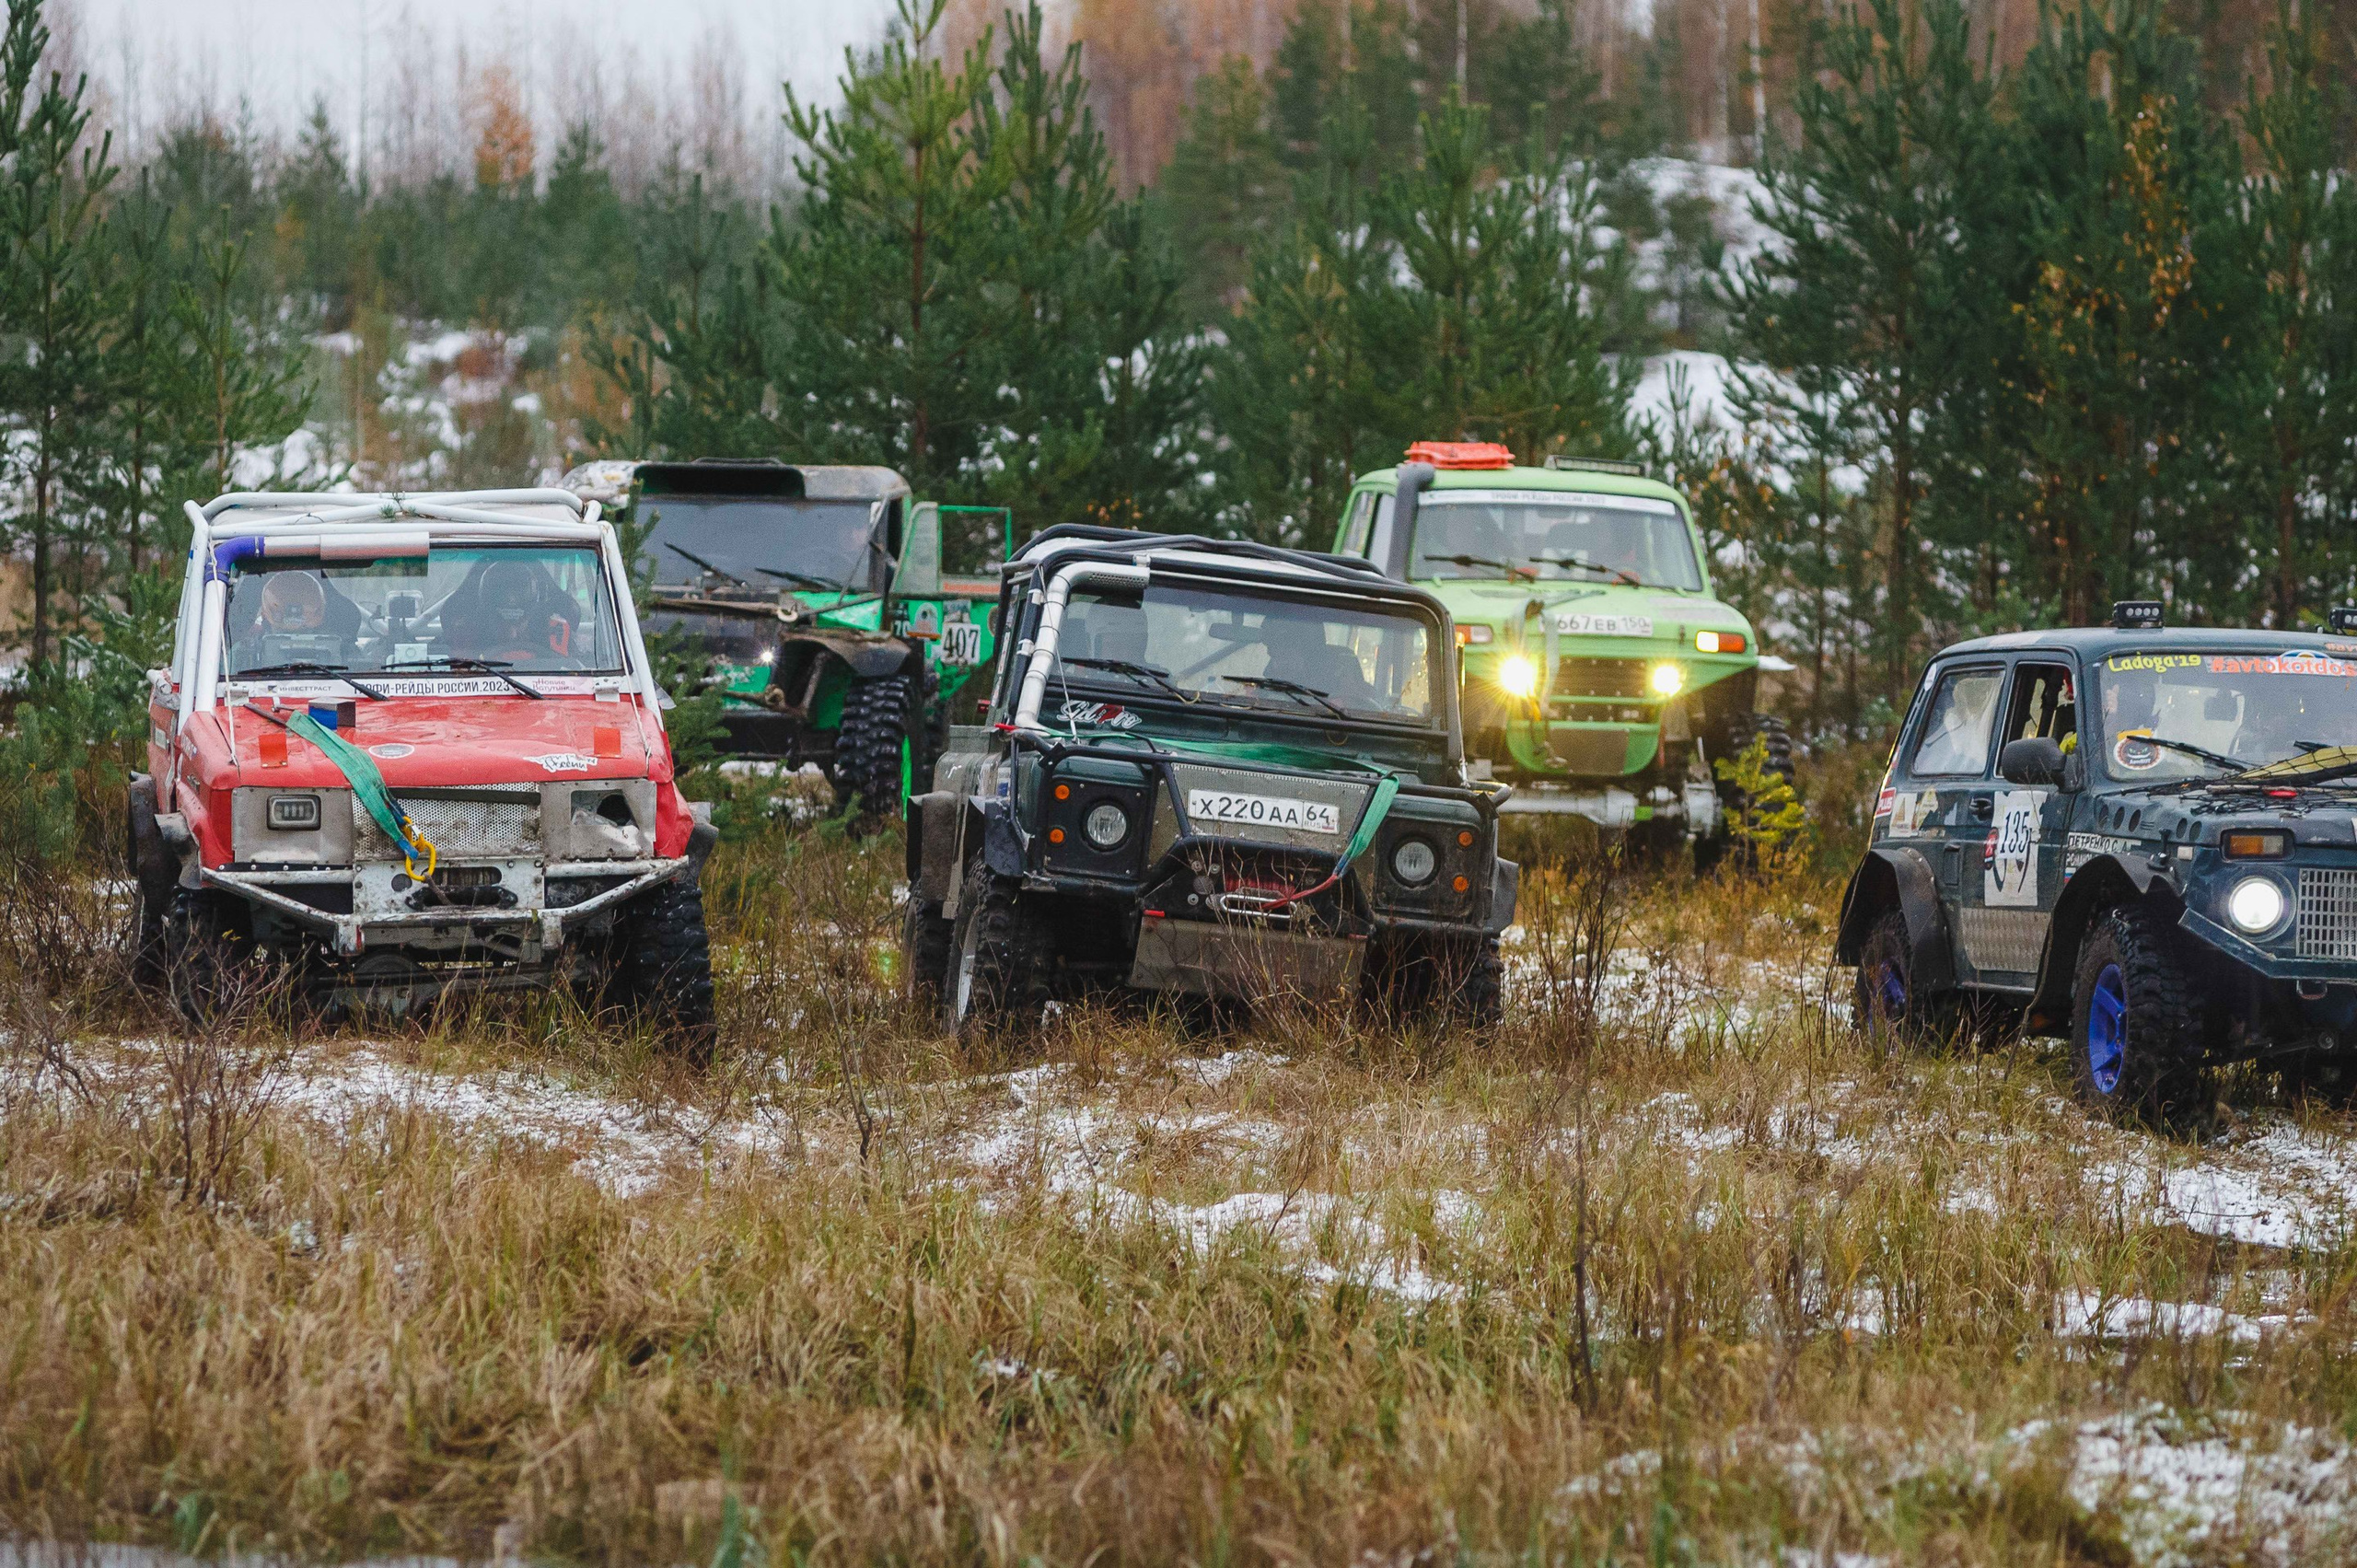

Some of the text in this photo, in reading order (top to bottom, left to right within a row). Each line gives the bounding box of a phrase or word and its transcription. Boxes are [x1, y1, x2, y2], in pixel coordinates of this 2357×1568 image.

[943, 627, 979, 658] 407
[2108, 651, 2201, 673] Ladoga'19
[354, 681, 435, 695] ОФИ-РЕЙДЫ
[1306, 805, 1329, 825] 64
[2000, 810, 2030, 854] 135
[2068, 834, 2110, 852] ПЕТРЕНКО
